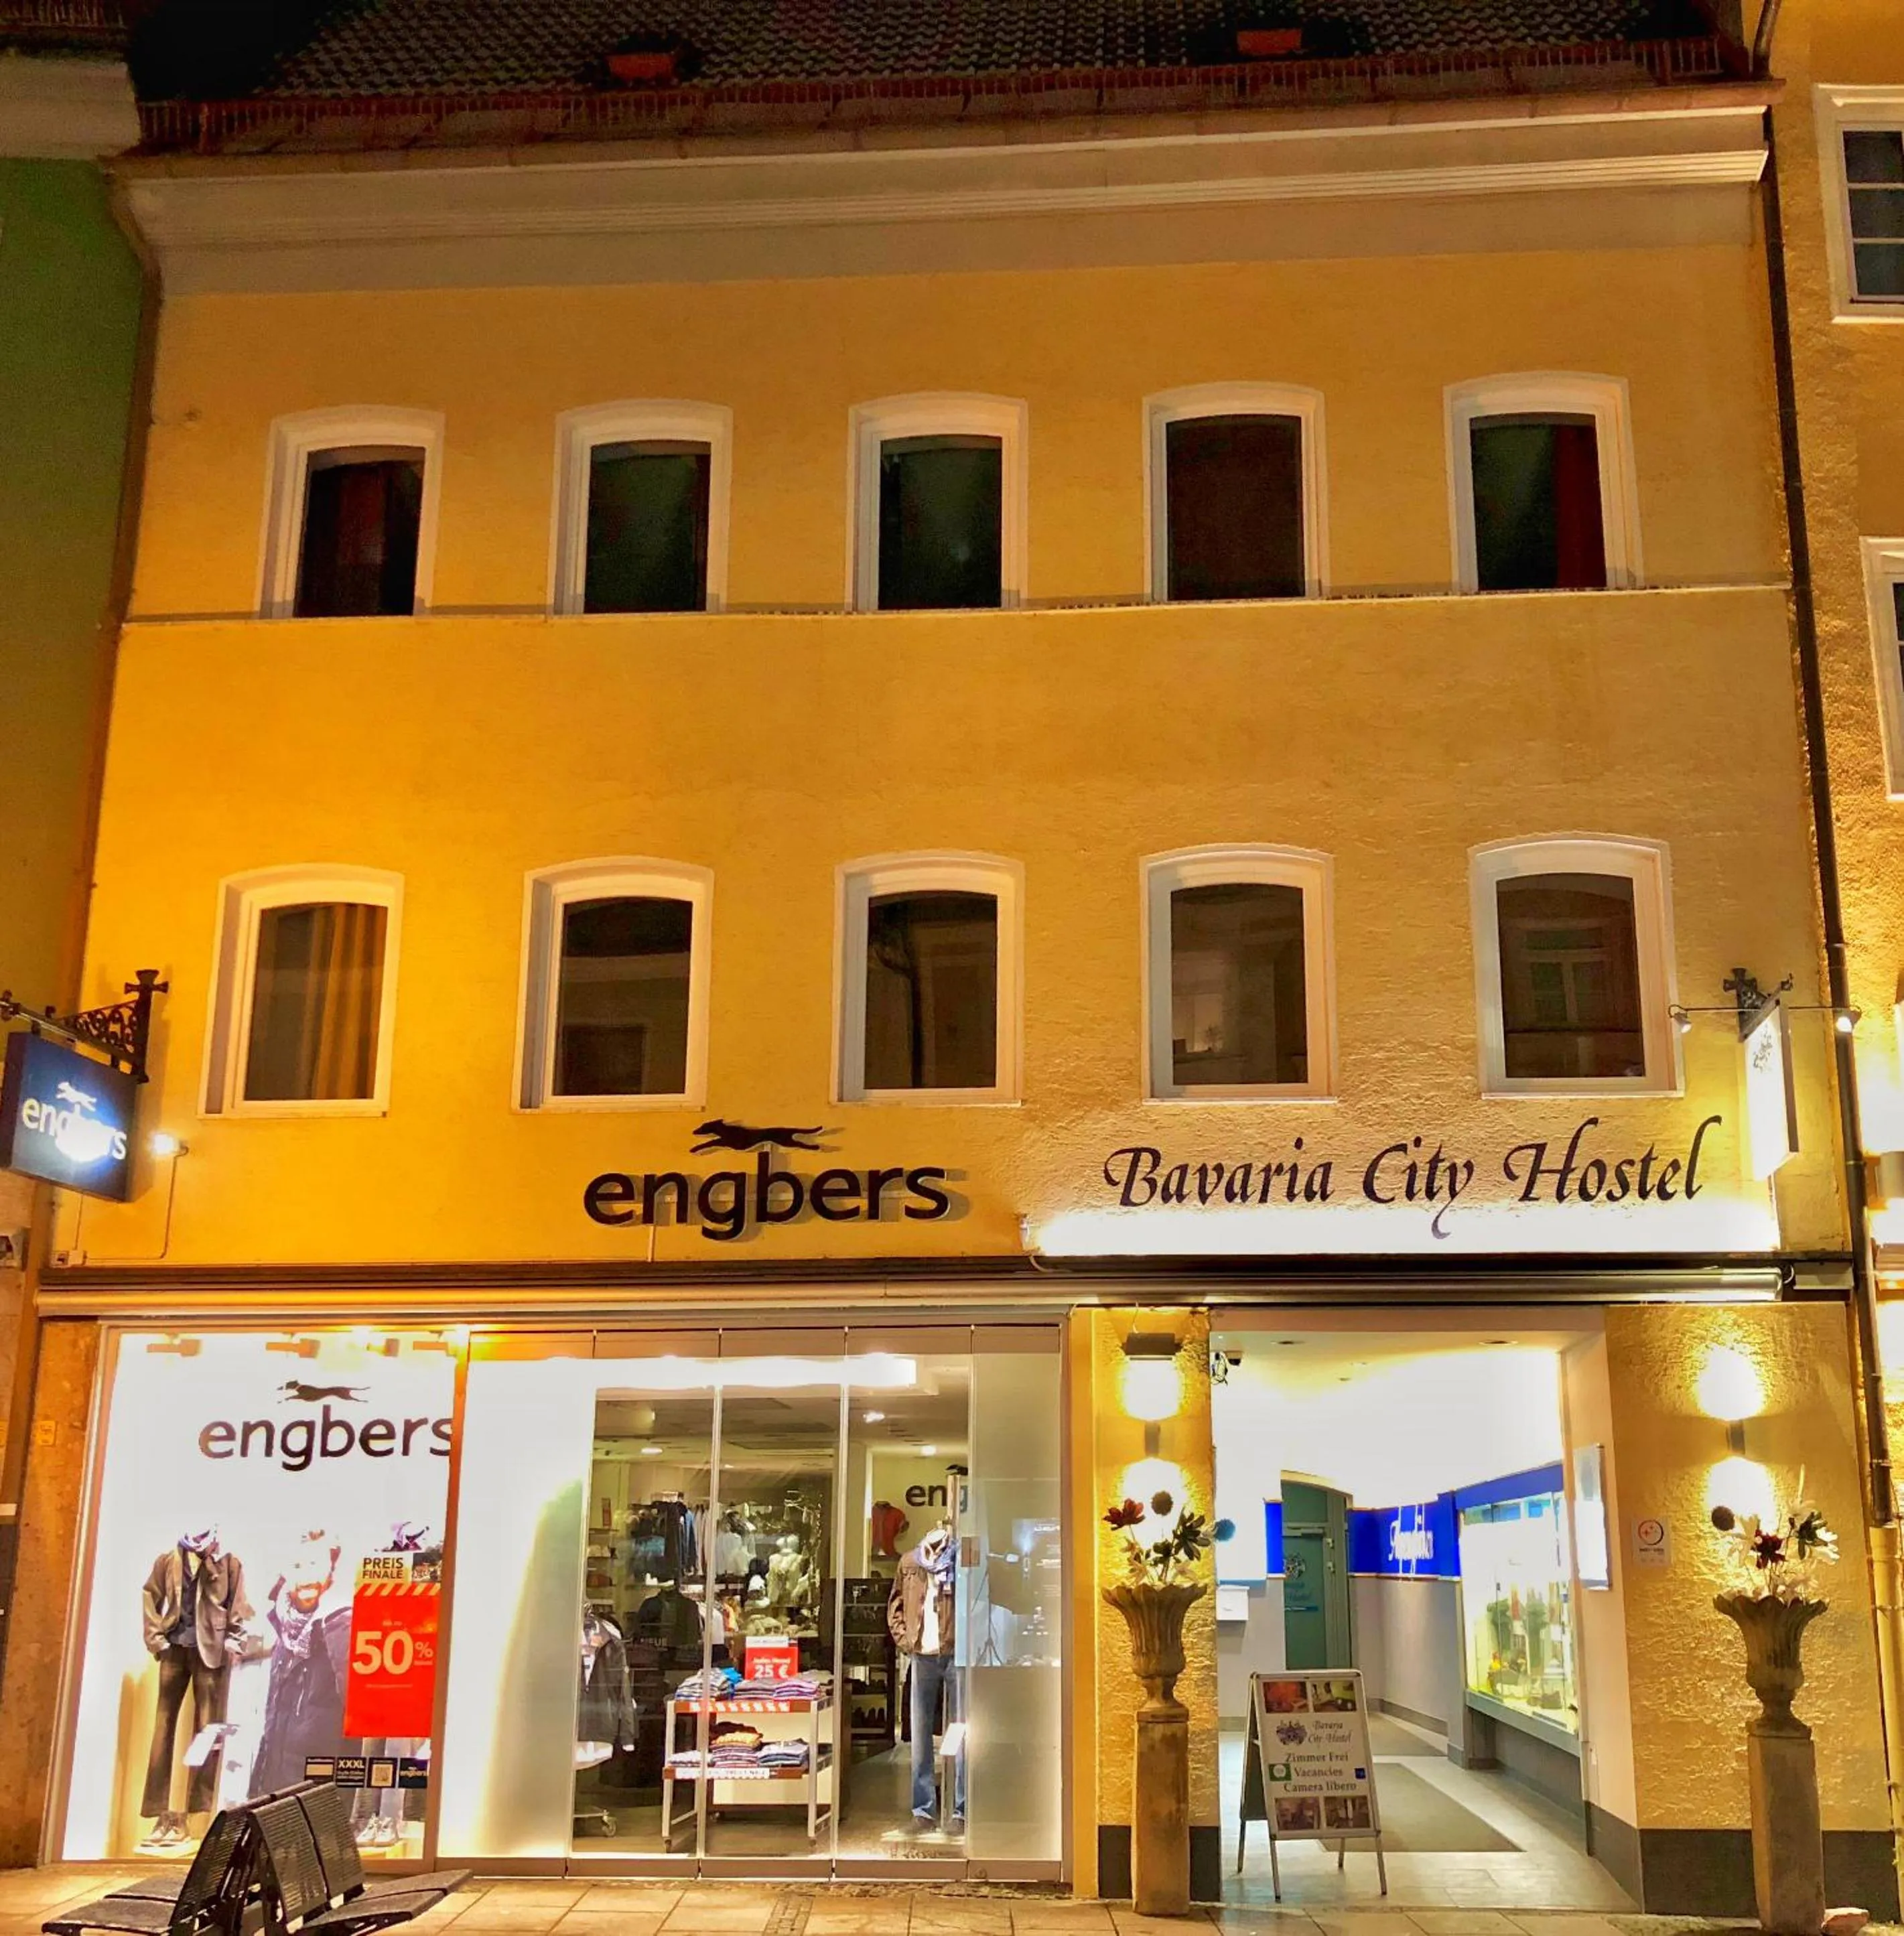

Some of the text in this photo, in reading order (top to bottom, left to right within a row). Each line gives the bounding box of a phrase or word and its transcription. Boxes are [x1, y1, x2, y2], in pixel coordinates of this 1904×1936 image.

[1103, 1115, 1722, 1240] Bavaria City Hostel
[584, 1151, 950, 1241] engbers
[198, 1404, 454, 1472] engbers
[362, 1557, 404, 1570] PREIS
[362, 1570, 404, 1580] FINALE
[754, 1664, 774, 1679] 25
[1286, 1751, 1349, 1762] Zimmer Frei
[338, 1759, 364, 1769] XXXL
[1293, 1767, 1343, 1777] Vacancies
[1283, 1781, 1357, 1793] Camera libero
